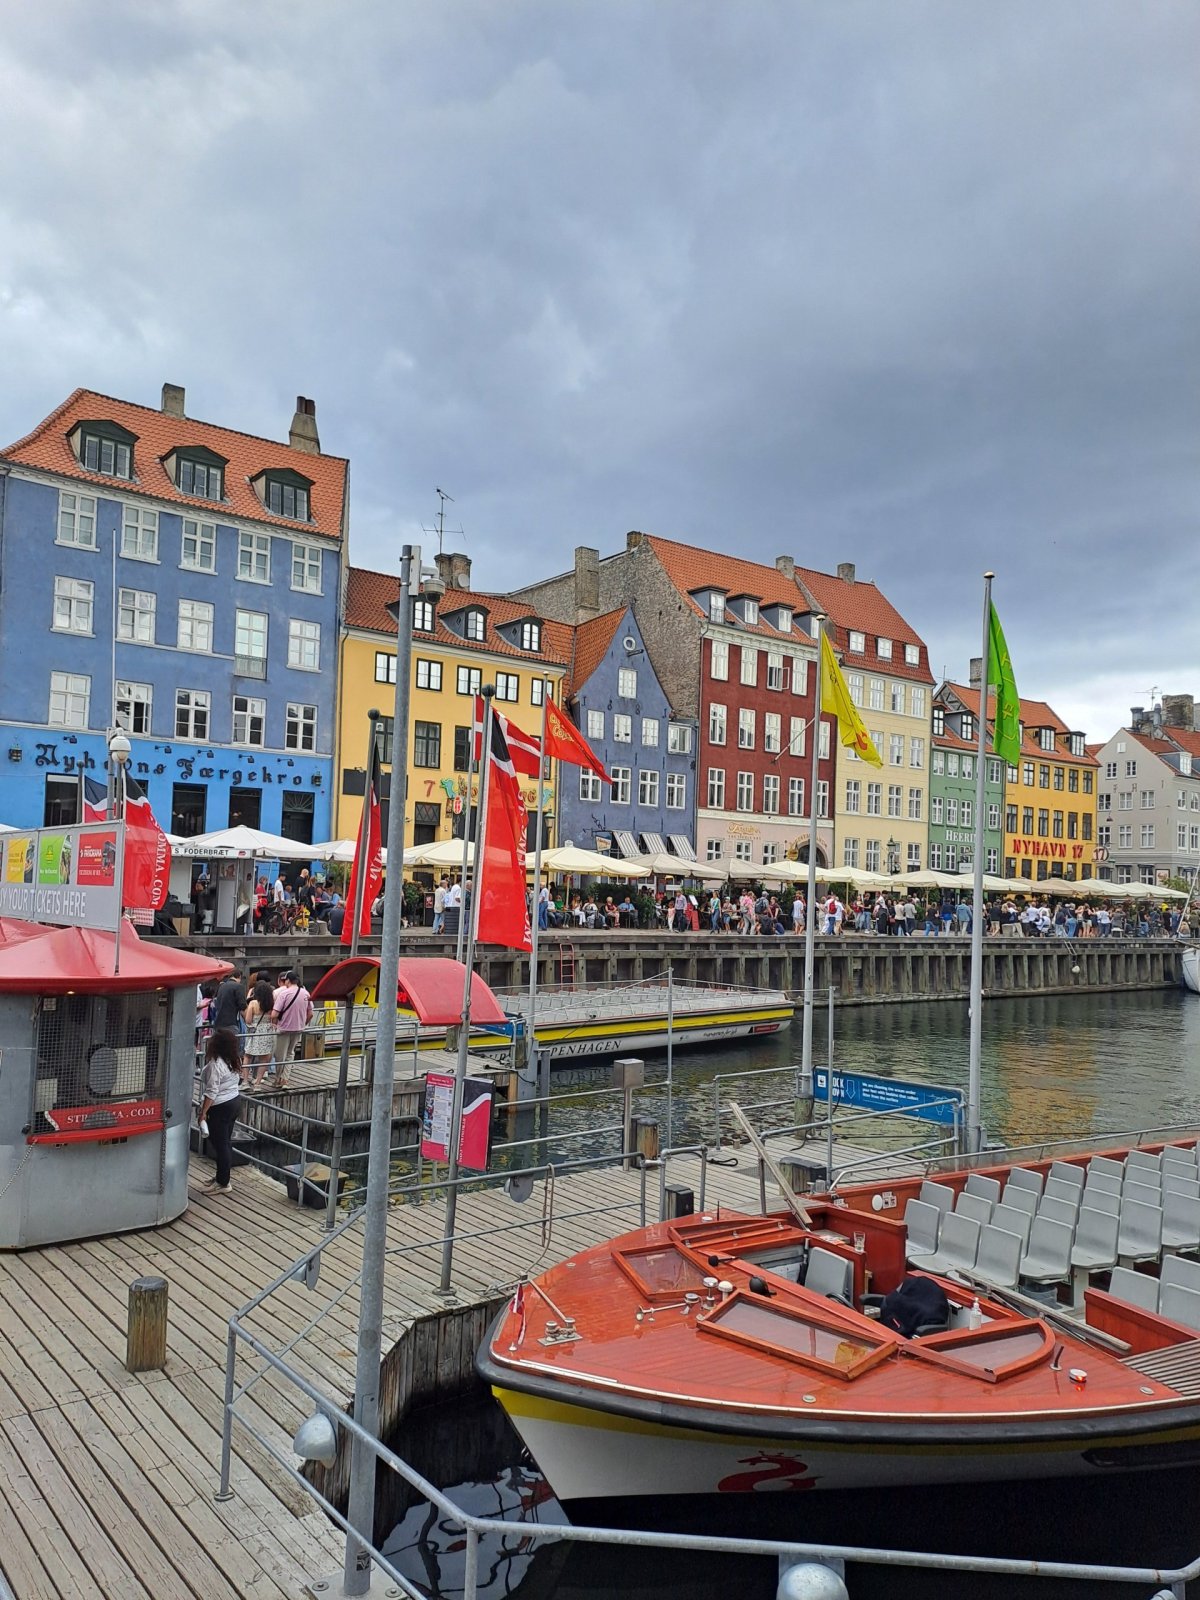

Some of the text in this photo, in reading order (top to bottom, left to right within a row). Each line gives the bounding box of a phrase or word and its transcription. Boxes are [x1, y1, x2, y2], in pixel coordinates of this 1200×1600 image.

[1013, 839, 1084, 859] NYHAVN 17
[8, 888, 29, 911] YOUR
[30, 889, 61, 915] TICKETS
[62, 891, 87, 918] HERE
[363, 987, 370, 1005] 2
